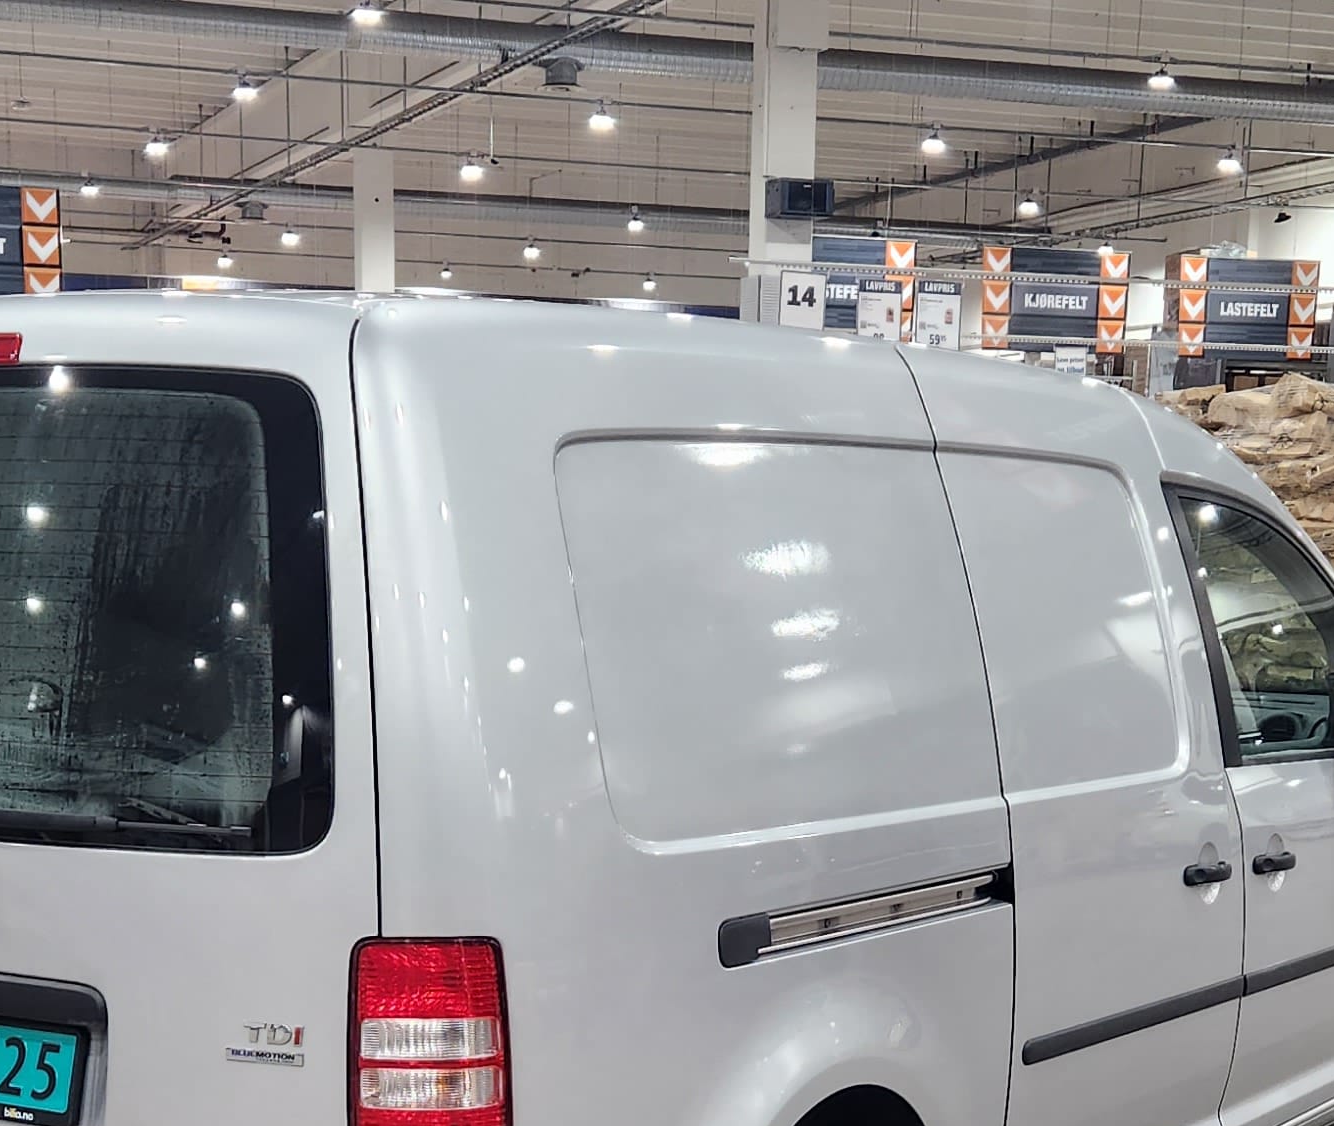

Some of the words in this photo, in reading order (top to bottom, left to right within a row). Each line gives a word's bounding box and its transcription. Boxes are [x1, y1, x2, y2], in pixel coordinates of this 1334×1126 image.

[787, 284, 816, 307] 14
[924, 282, 955, 294] LAVPRIS
[1024, 293, 1088, 310] KJØREFELT
[1219, 301, 1279, 318] LASTEFELT
[243, 1022, 305, 1047] TDI
